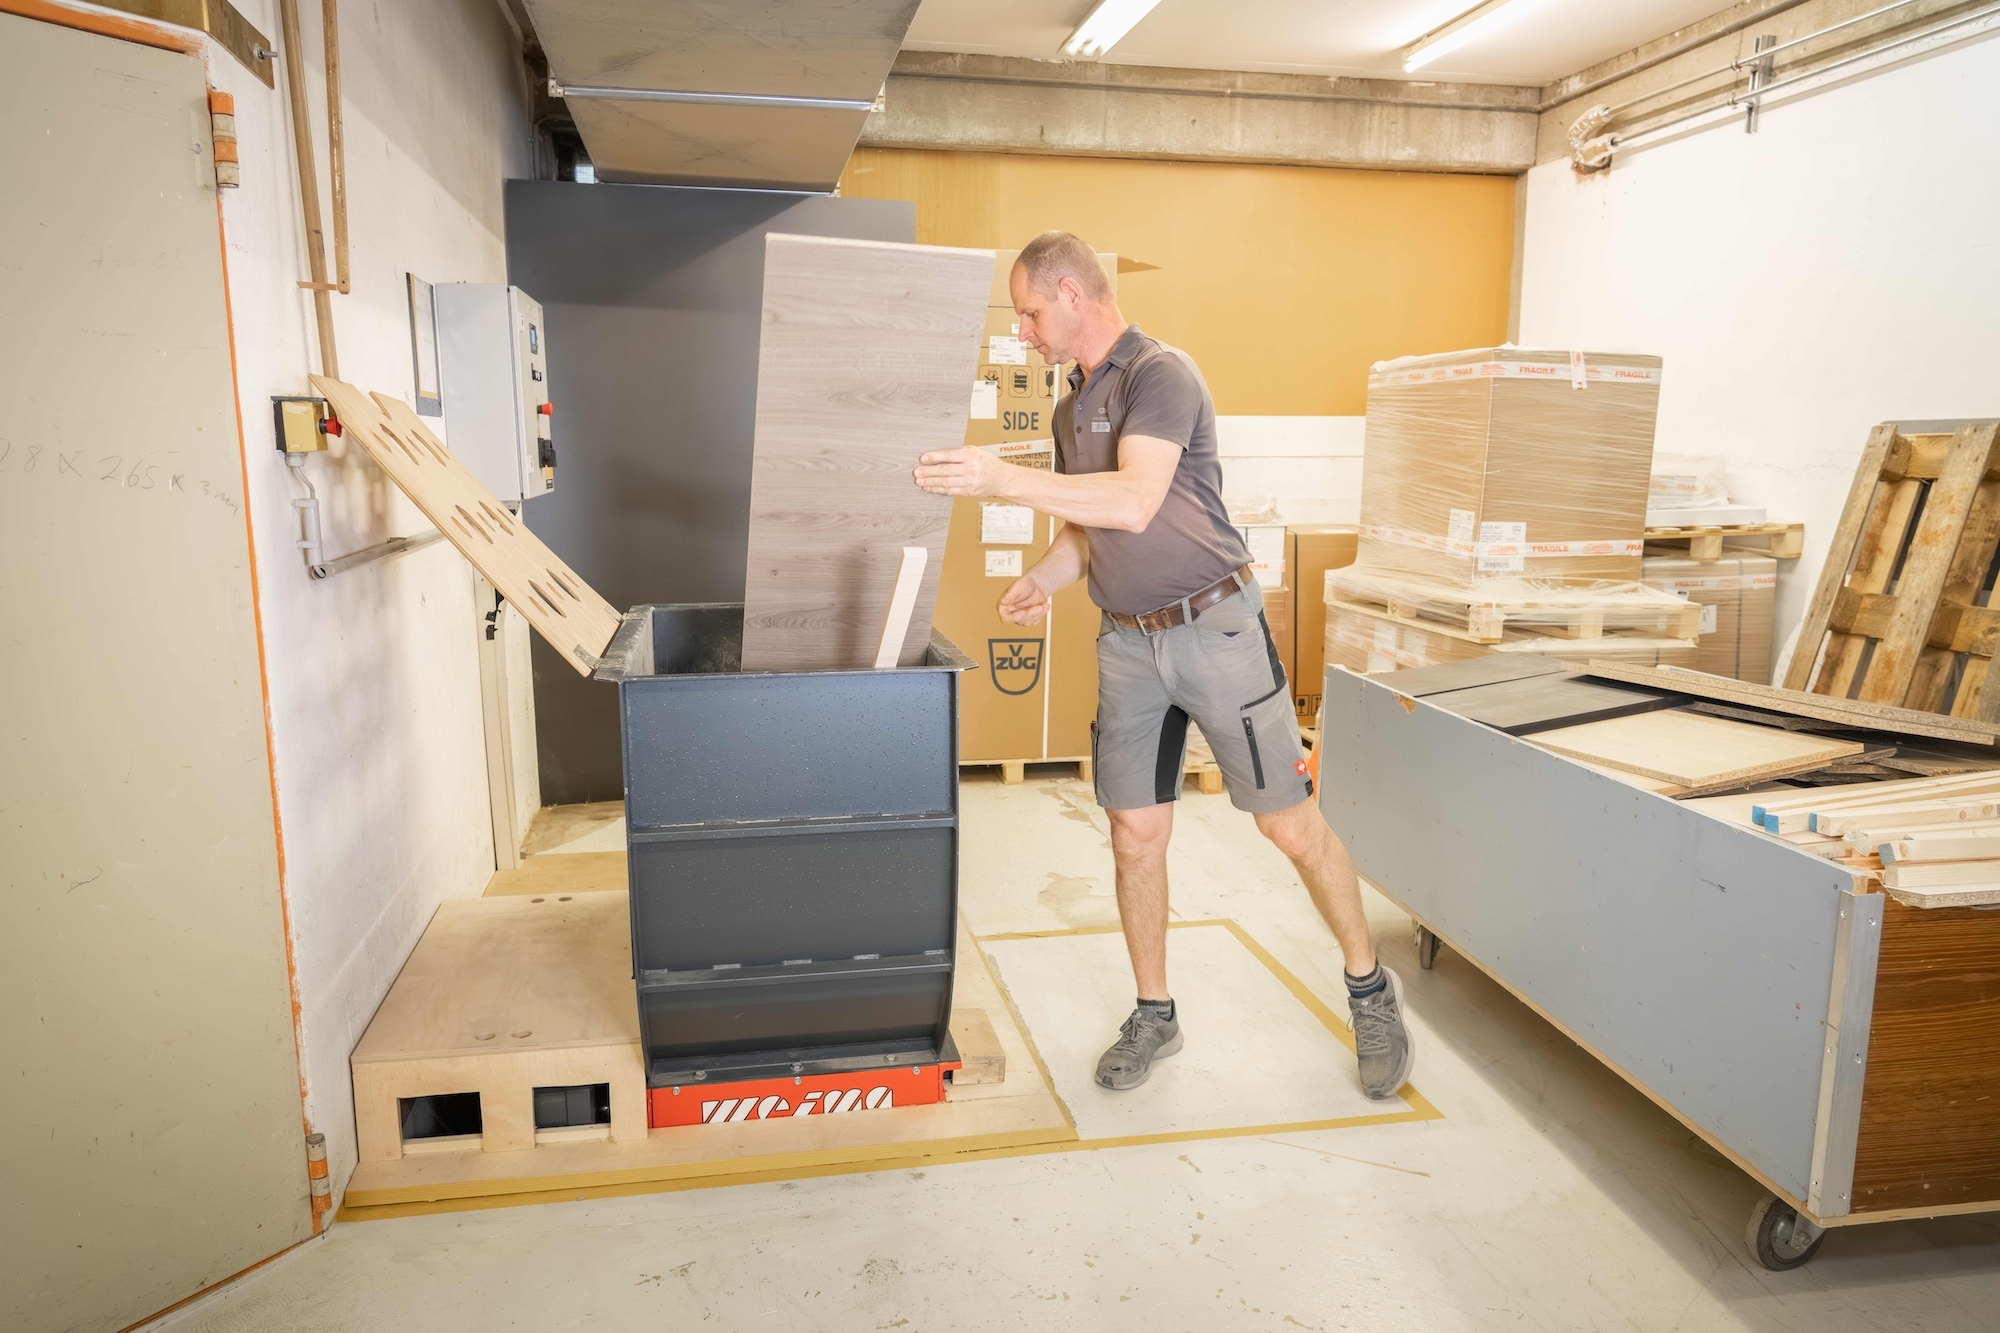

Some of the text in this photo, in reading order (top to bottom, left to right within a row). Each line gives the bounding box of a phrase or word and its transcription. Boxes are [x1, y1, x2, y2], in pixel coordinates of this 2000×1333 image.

[1519, 366, 1556, 375] FRAGILE
[1615, 371, 1652, 379] FRAGILE
[1003, 410, 1039, 431] SIDE
[999, 444, 1032, 453] FRAGILE
[1034, 461, 1052, 469] CARE
[98, 455, 161, 490] 265
[1532, 545, 1569, 553] FRAGILE
[1009, 644, 1023, 656] V
[996, 657, 1036, 670] ZUG
